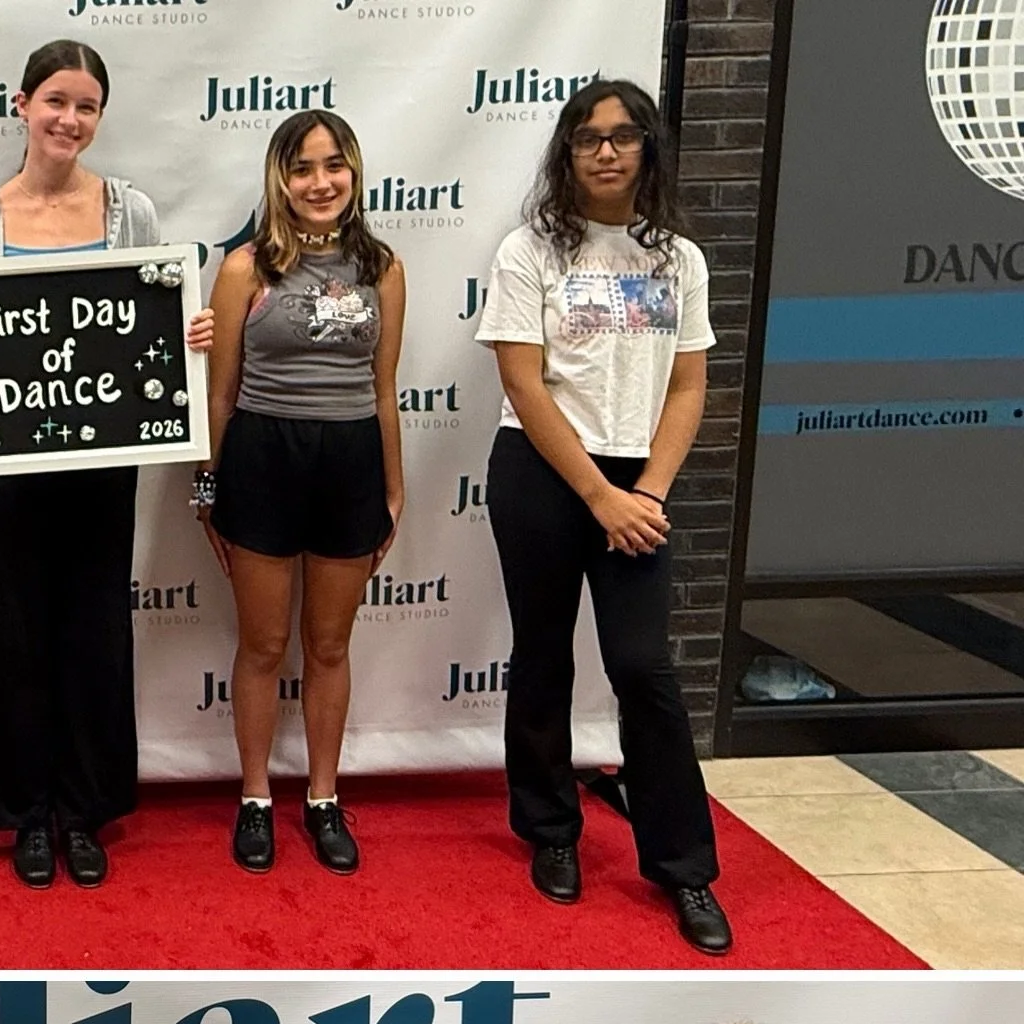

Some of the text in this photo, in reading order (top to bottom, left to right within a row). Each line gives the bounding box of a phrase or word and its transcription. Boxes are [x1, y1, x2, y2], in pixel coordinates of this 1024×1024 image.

[91, 12, 208, 26] DANCE STUDIO
[358, 5, 475, 19] DANCE STUDIO
[200, 75, 337, 122] Juliart
[221, 118, 272, 130] DANCE
[486, 110, 538, 122] DANCE
[410, 216, 464, 229] STUDIO
[71, 296, 136, 335] Day
[42, 337, 76, 373] of
[139, 419, 184, 440] 2026
[405, 418, 460, 430] STUDIO
[796, 408, 988, 435] juliartdance.com
[131, 578, 200, 610] iart
